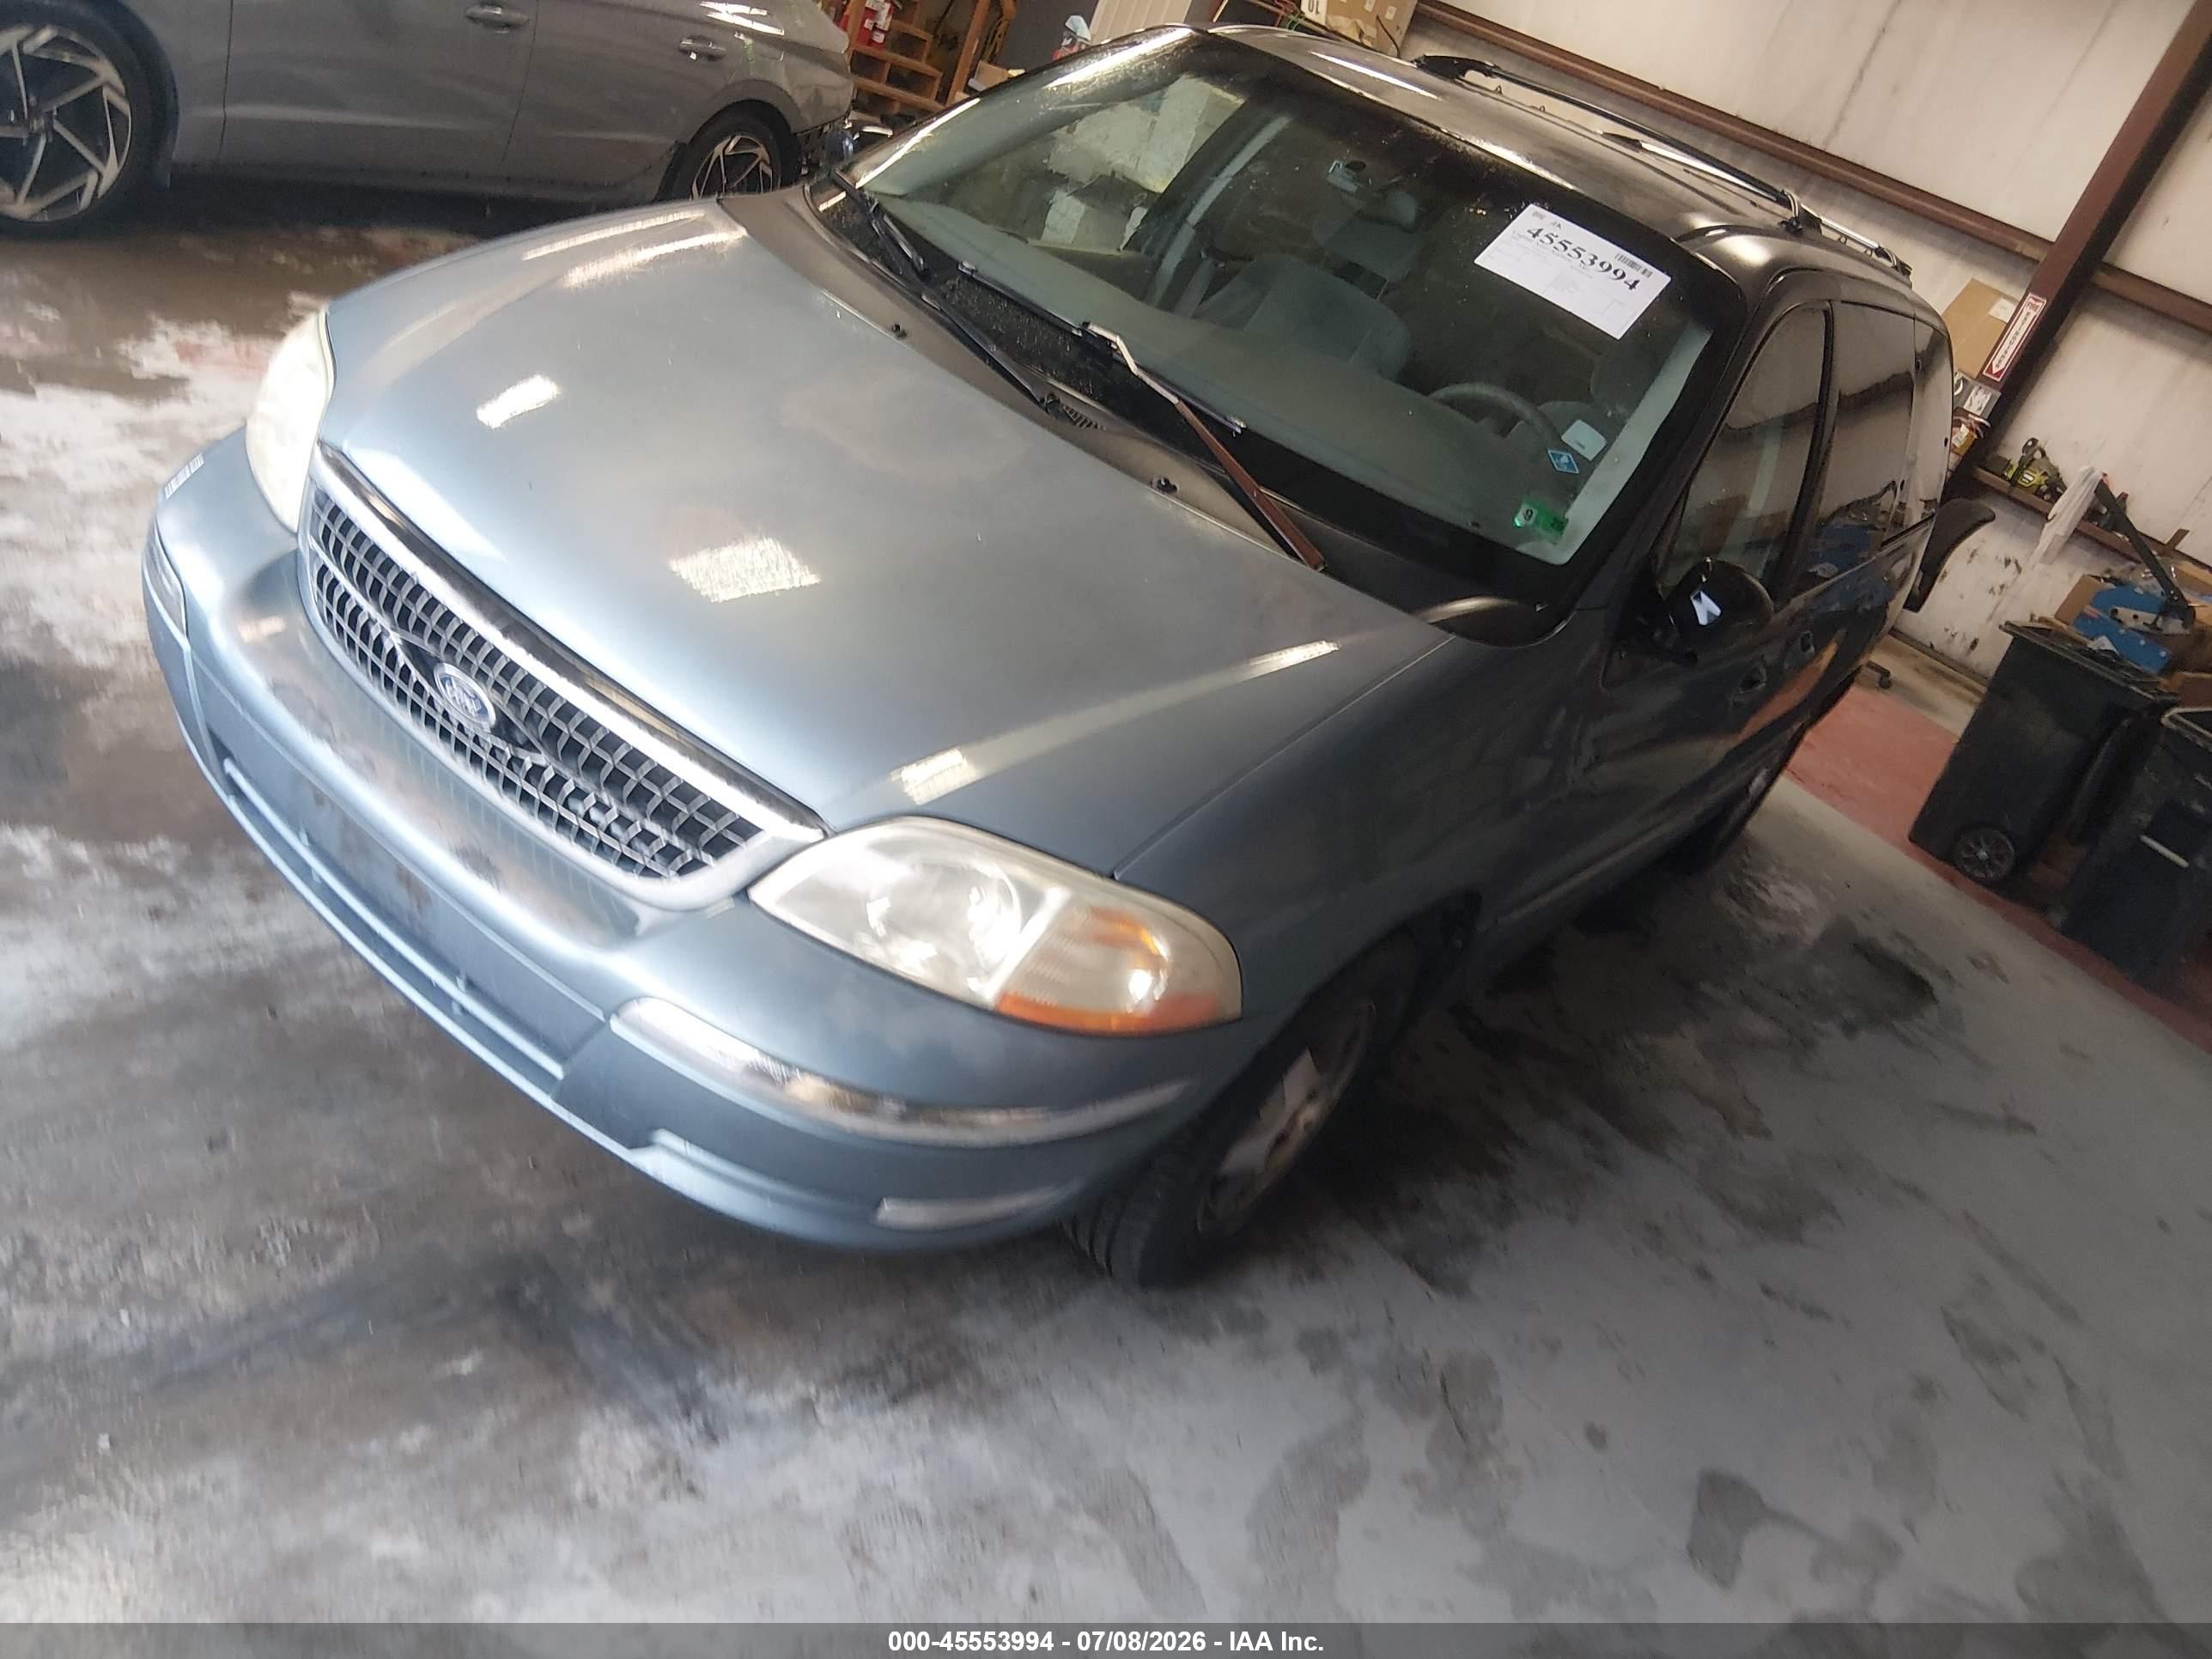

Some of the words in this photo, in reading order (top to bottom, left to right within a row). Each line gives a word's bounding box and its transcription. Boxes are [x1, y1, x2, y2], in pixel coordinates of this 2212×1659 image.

[1527, 228, 1640, 290] 45553994
[2027, 301, 2039, 313] FIRE
[1995, 312, 2031, 368] EXTINGUISHER
